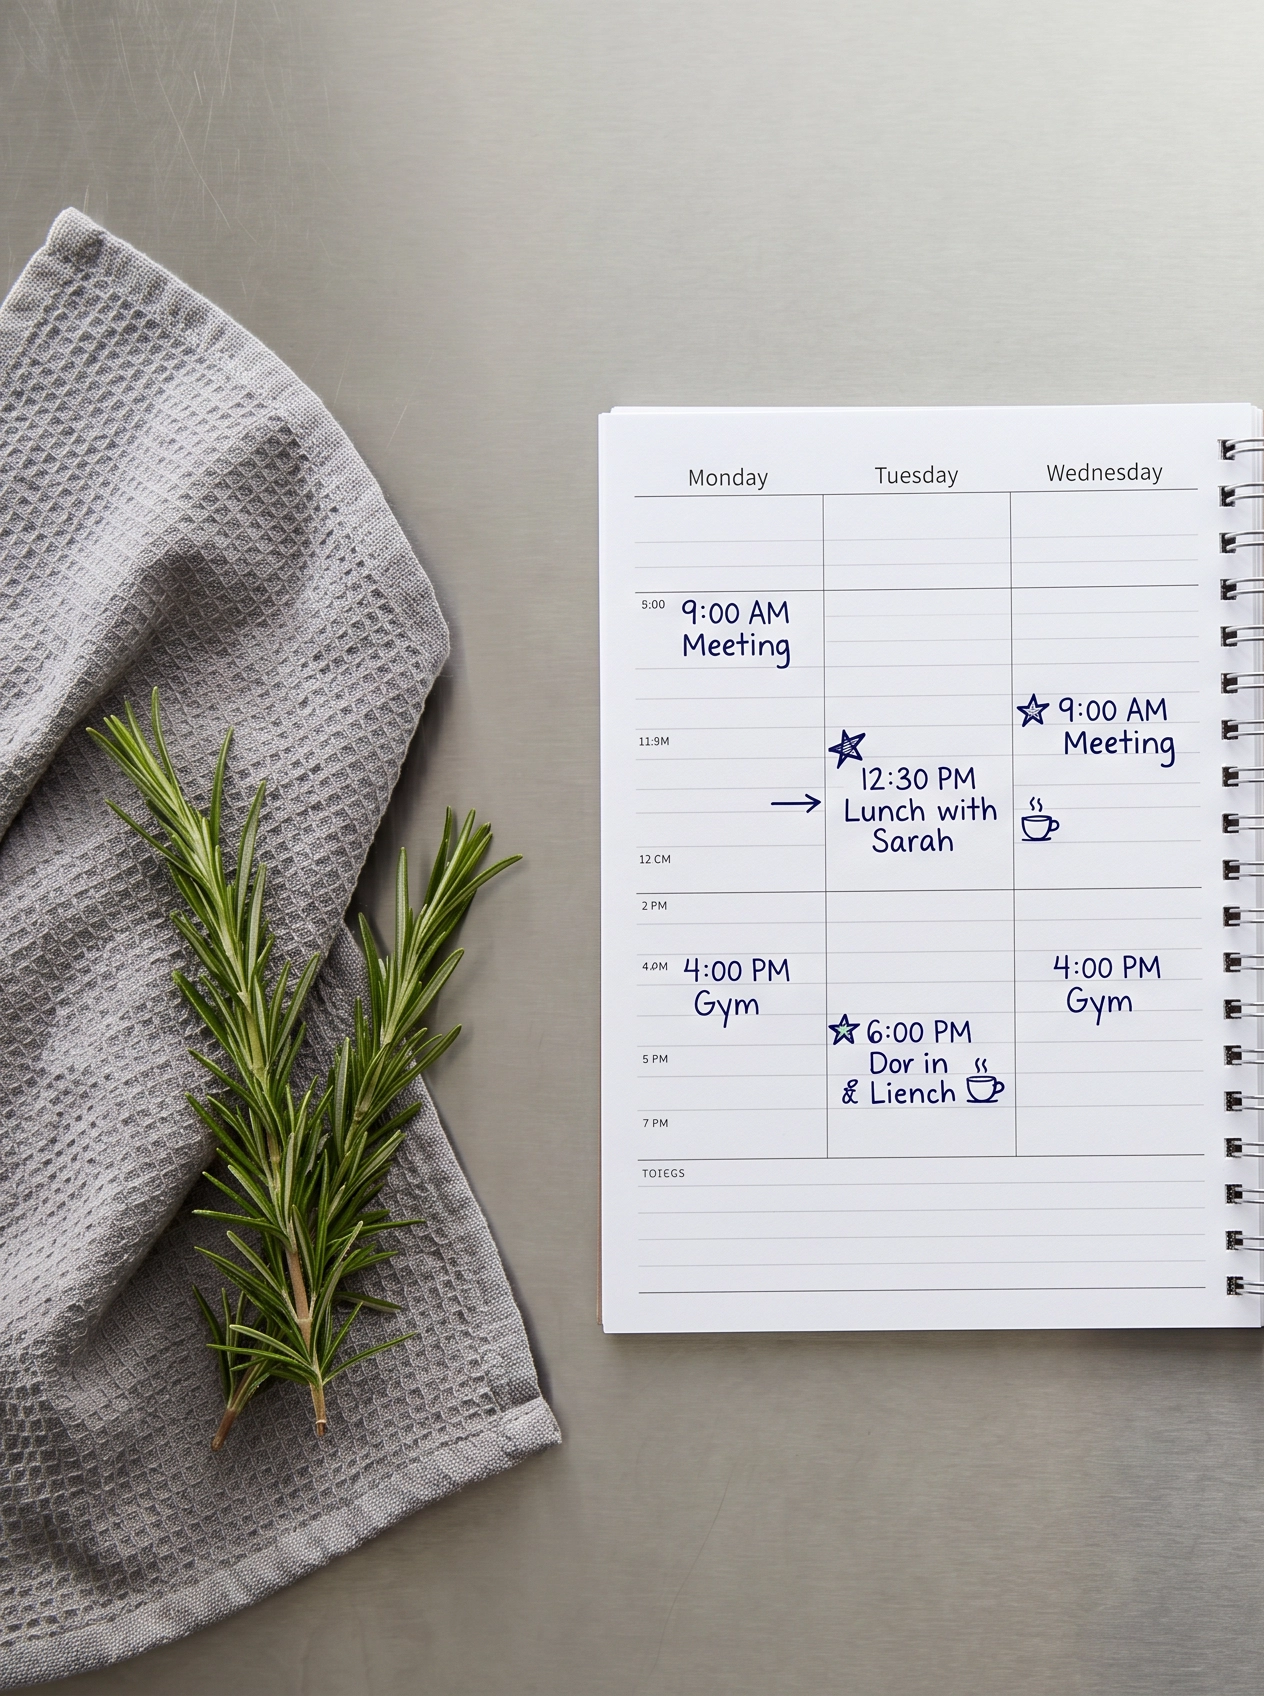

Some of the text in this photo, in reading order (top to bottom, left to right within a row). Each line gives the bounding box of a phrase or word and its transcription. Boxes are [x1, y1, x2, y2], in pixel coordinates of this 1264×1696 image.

[688, 467, 769, 491] Monday
[874, 464, 959, 489] Tuesday
[1046, 461, 1163, 486] Wednesday
[681, 599, 790, 626] 9:00 AM
[683, 631, 791, 670] Meeting
[1058, 696, 1168, 723] 9:00 AM
[1064, 729, 1176, 769] Meeting
[861, 766, 976, 791] 12:30 PM
[844, 795, 998, 823] Lunch with
[871, 827, 954, 854] Sarah
[639, 854, 652, 865] 12
[641, 900, 668, 911] 2 PM
[683, 957, 791, 983] 4:00 PM
[1053, 954, 1161, 980] 4:00 PM
[694, 989, 760, 1029] Gym
[1066, 986, 1133, 1027] Gym
[866, 1018, 972, 1045] 6:00 PM
[642, 1054, 669, 1064] 5 PM
[869, 1050, 948, 1075] Dor in
[642, 1118, 669, 1128] 7 PM
